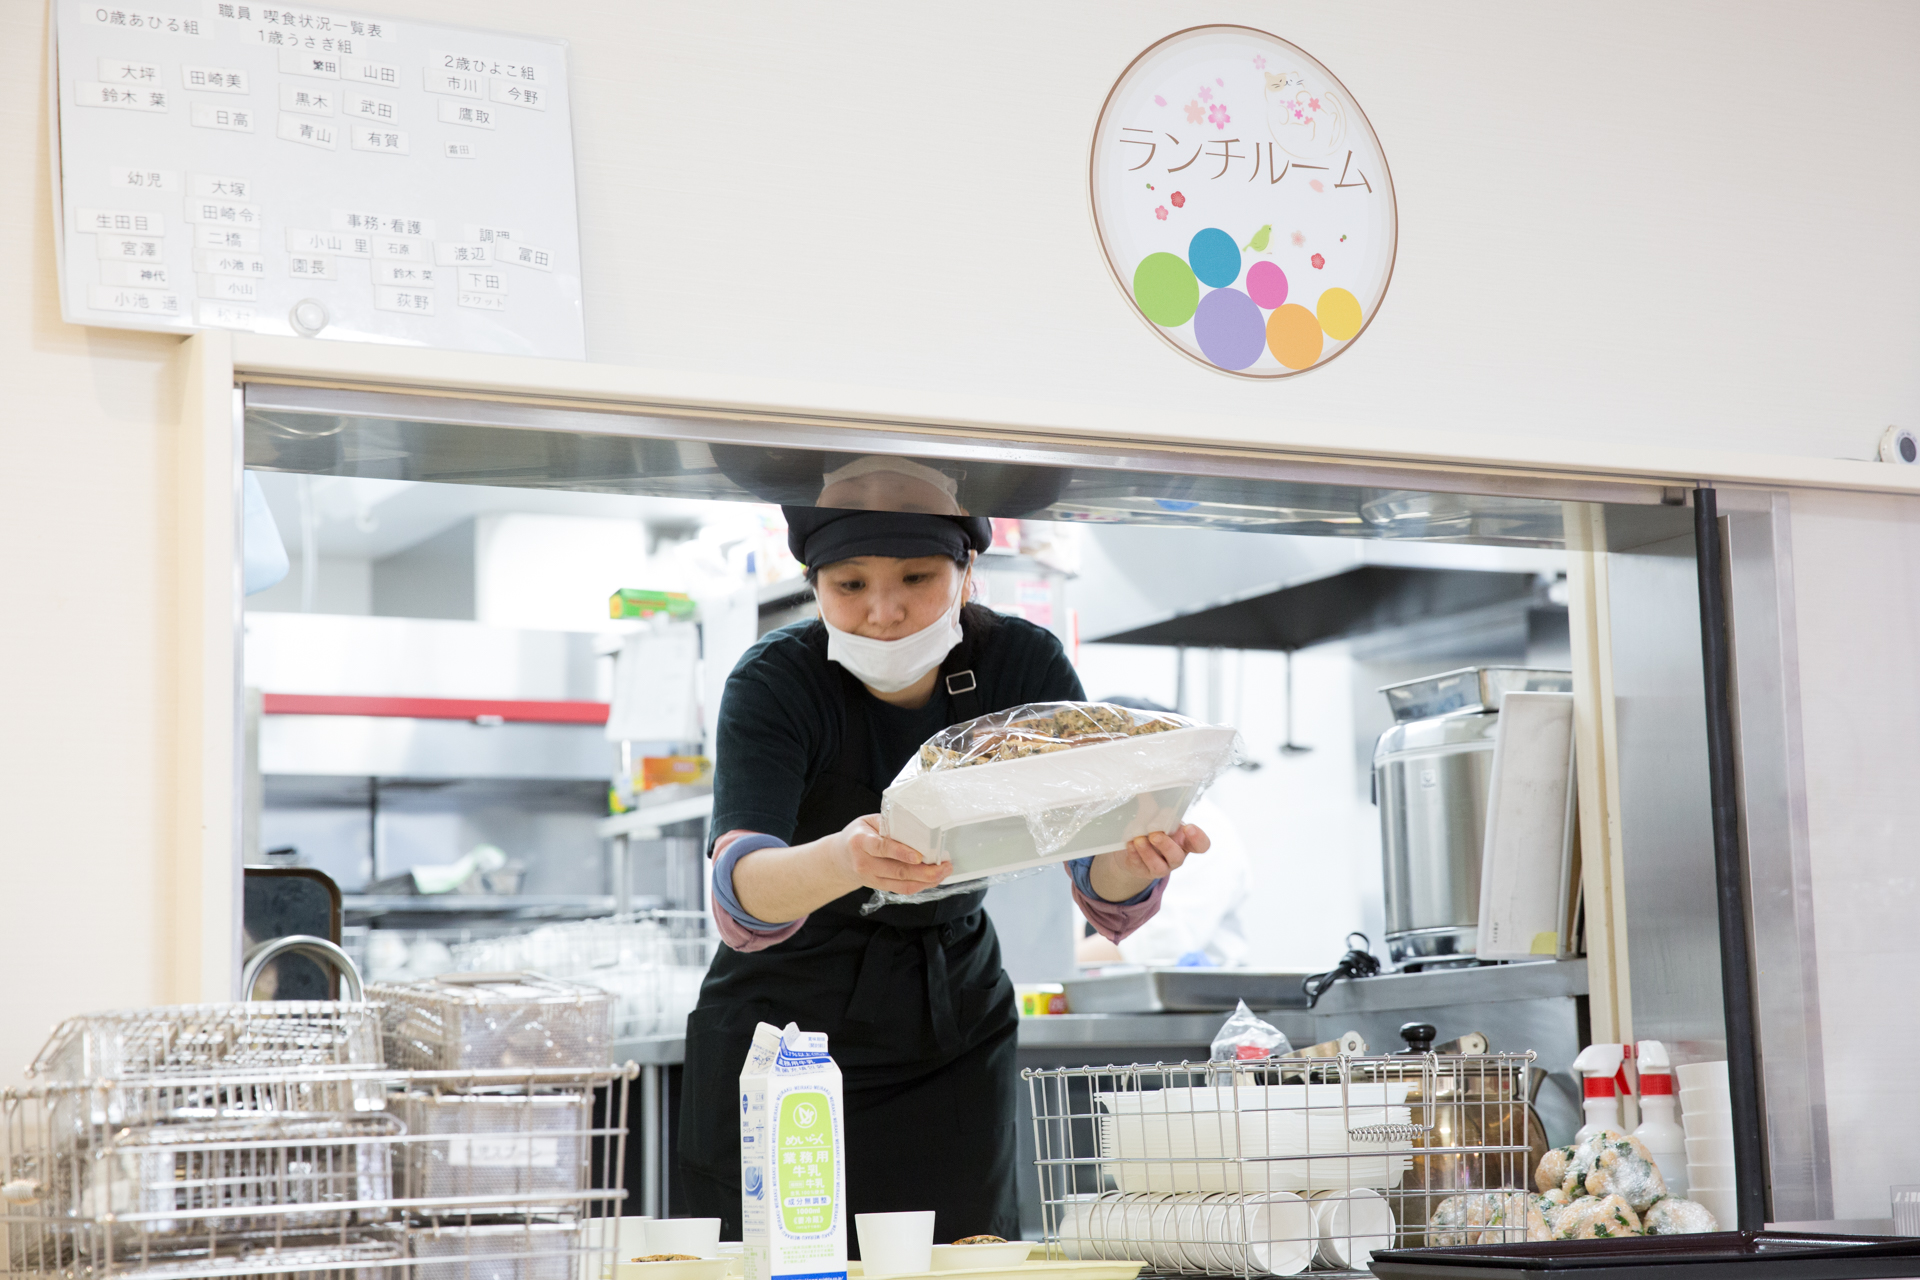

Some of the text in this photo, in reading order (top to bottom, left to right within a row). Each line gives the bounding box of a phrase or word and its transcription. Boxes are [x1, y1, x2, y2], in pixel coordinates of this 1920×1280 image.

[218, 3, 382, 38] 職員 喫食状況一覧表
[258, 30, 353, 55] 1歳うさぎ組
[121, 64, 156, 82] 大坪
[364, 65, 395, 83] 山田
[444, 54, 535, 82] 2歳ひよこ組
[447, 76, 478, 93] 市川
[102, 87, 167, 108] 鈴木 葉
[295, 92, 329, 109] 黒木
[507, 86, 538, 105] 今野
[361, 99, 393, 118] 武田
[458, 107, 490, 125] 鷹取
[216, 110, 249, 128] 日高
[299, 123, 332, 143] 青山
[367, 131, 400, 149] 有賀
[1119, 126, 1373, 194] ランチルーム
[127, 170, 163, 188] 幼児
[211, 180, 247, 197] 大塚
[96, 214, 149, 231] 生田目
[347, 213, 422, 236] 事務・看護
[121, 240, 157, 257] 宮澤
[208, 231, 242, 248] 二橋
[309, 234, 342, 252] 小山
[387, 242, 410, 255] 石原
[454, 246, 486, 262] 渡辺
[219, 258, 245, 271] 小池
[292, 258, 326, 276] 園長
[228, 282, 254, 296] 小山
[468, 272, 500, 290] 下田
[785, 1133, 825, 1146] めいらく
[783, 1150, 829, 1164] 業務用
[792, 1164, 822, 1177] 牛乳
[805, 1178, 825, 1189] 牛乳
